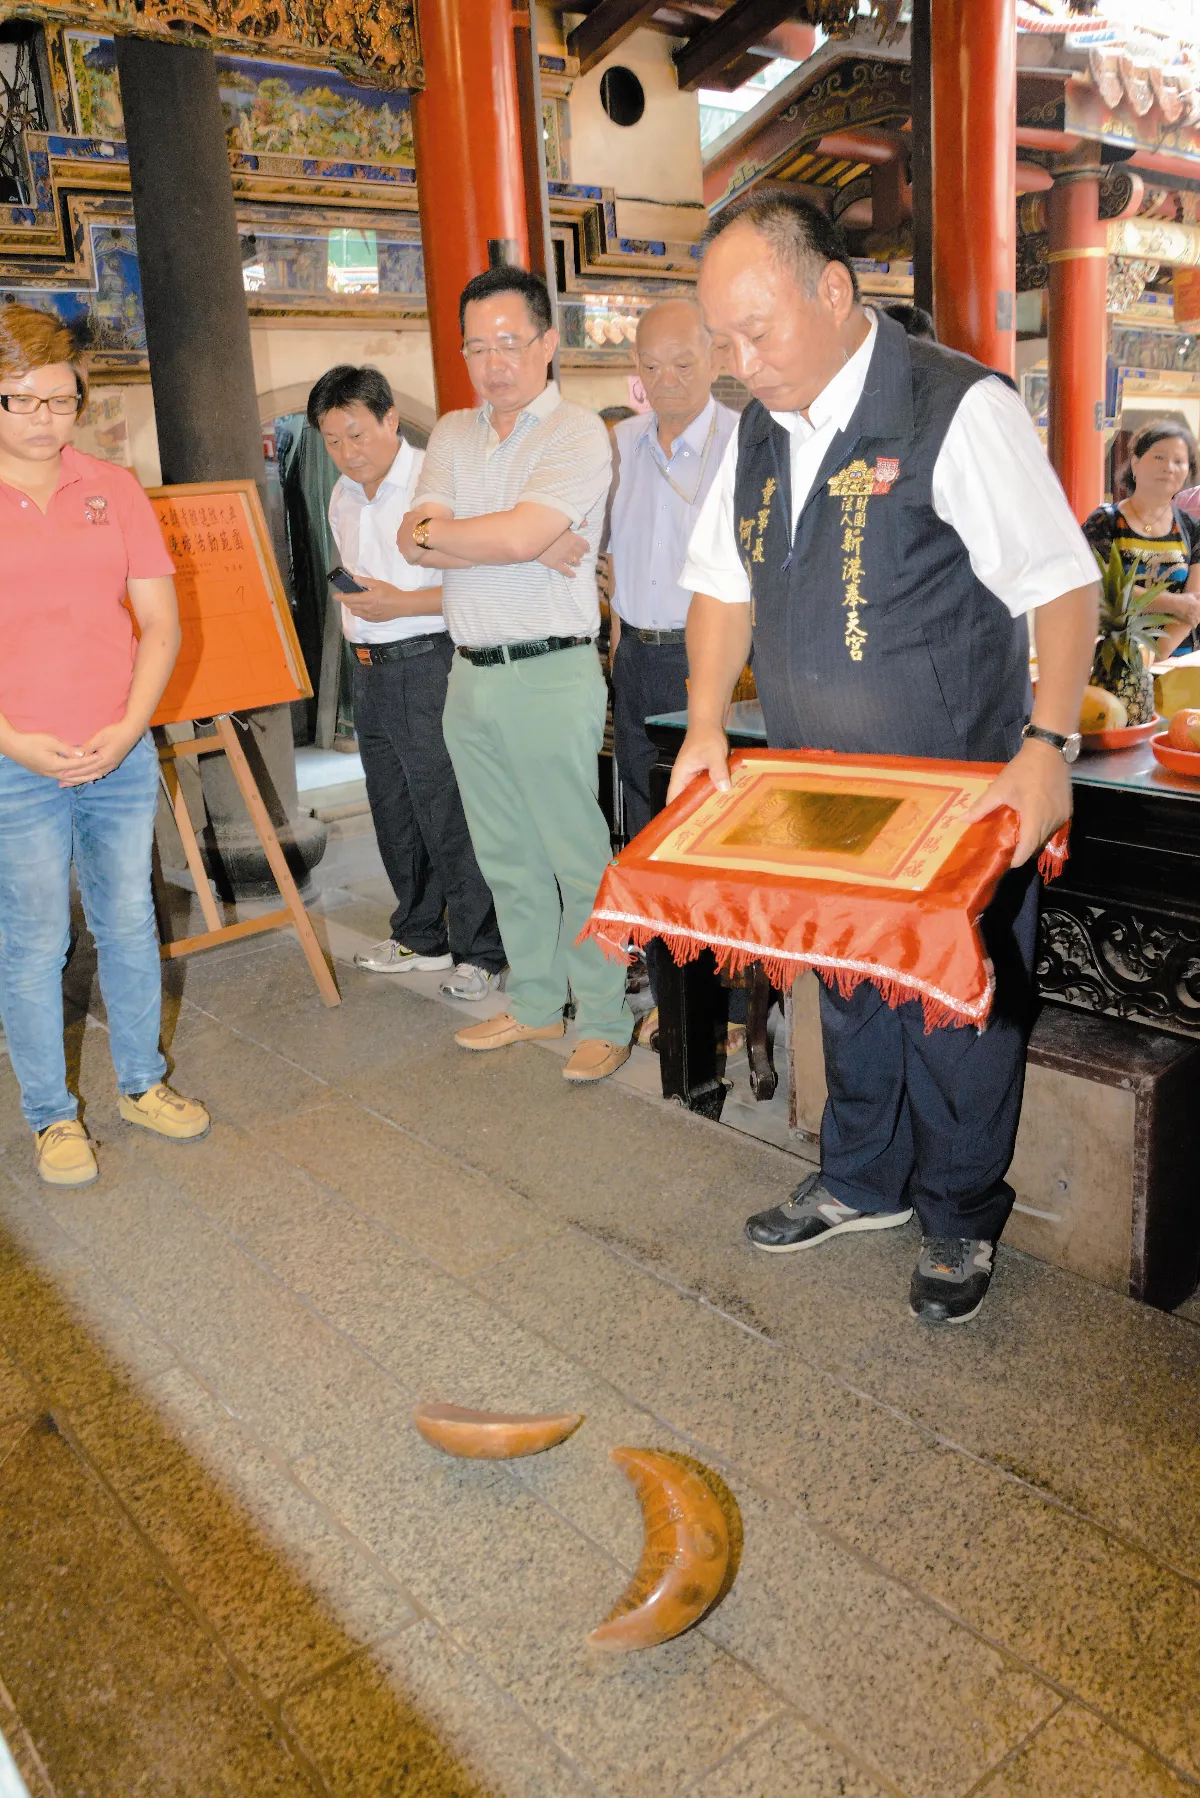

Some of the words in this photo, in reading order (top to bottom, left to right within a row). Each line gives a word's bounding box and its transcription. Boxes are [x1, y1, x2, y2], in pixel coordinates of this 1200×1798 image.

[840, 528, 868, 661] 新港奉天宮
